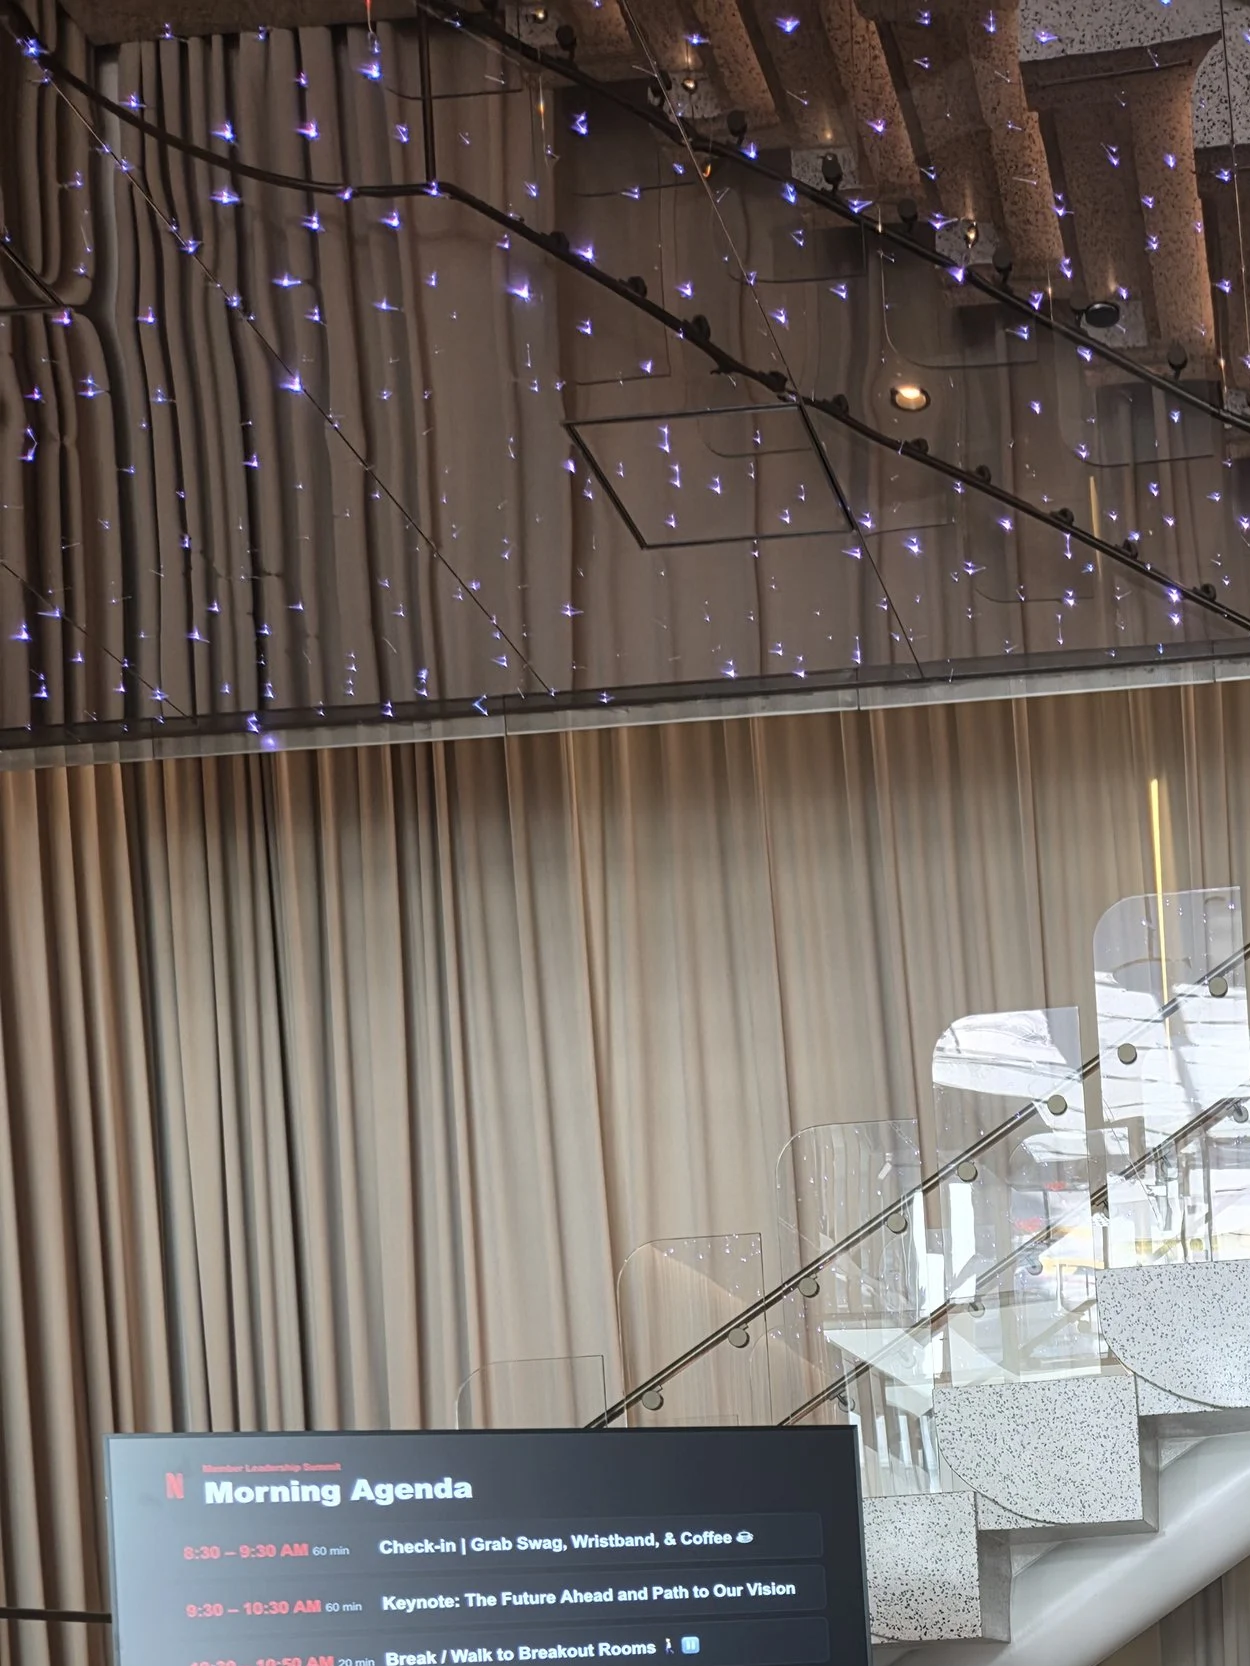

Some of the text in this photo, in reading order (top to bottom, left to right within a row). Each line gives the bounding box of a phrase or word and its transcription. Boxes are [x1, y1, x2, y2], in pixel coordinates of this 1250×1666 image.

[204, 1477, 473, 1507] Morning Agenda
[183, 1545, 220, 1560] 8:30
[239, 1544, 276, 1558] 9:30
[280, 1543, 309, 1557] AM
[312, 1546, 327, 1556] 60
[329, 1545, 350, 1556] min
[379, 1538, 457, 1554] Check-in
[471, 1537, 512, 1552] Grab
[516, 1535, 567, 1552] Swag,
[570, 1533, 660, 1549] Wristband,
[663, 1532, 677, 1546] &
[680, 1530, 732, 1546] Coffee
[186, 1603, 223, 1618] 9:30
[243, 1601, 289, 1615] 10:30
[293, 1600, 322, 1614] AM
[325, 1602, 340, 1612] 60
[342, 1601, 362, 1612] min
[381, 1581, 796, 1613] Keynote: The Future Ahead and Path to Our Vision
[385, 1650, 437, 1666] Break
[450, 1648, 493, 1663] Walk
[497, 1648, 515, 1662] to
[518, 1644, 595, 1661] Breakout
[598, 1642, 657, 1657] Rooms
